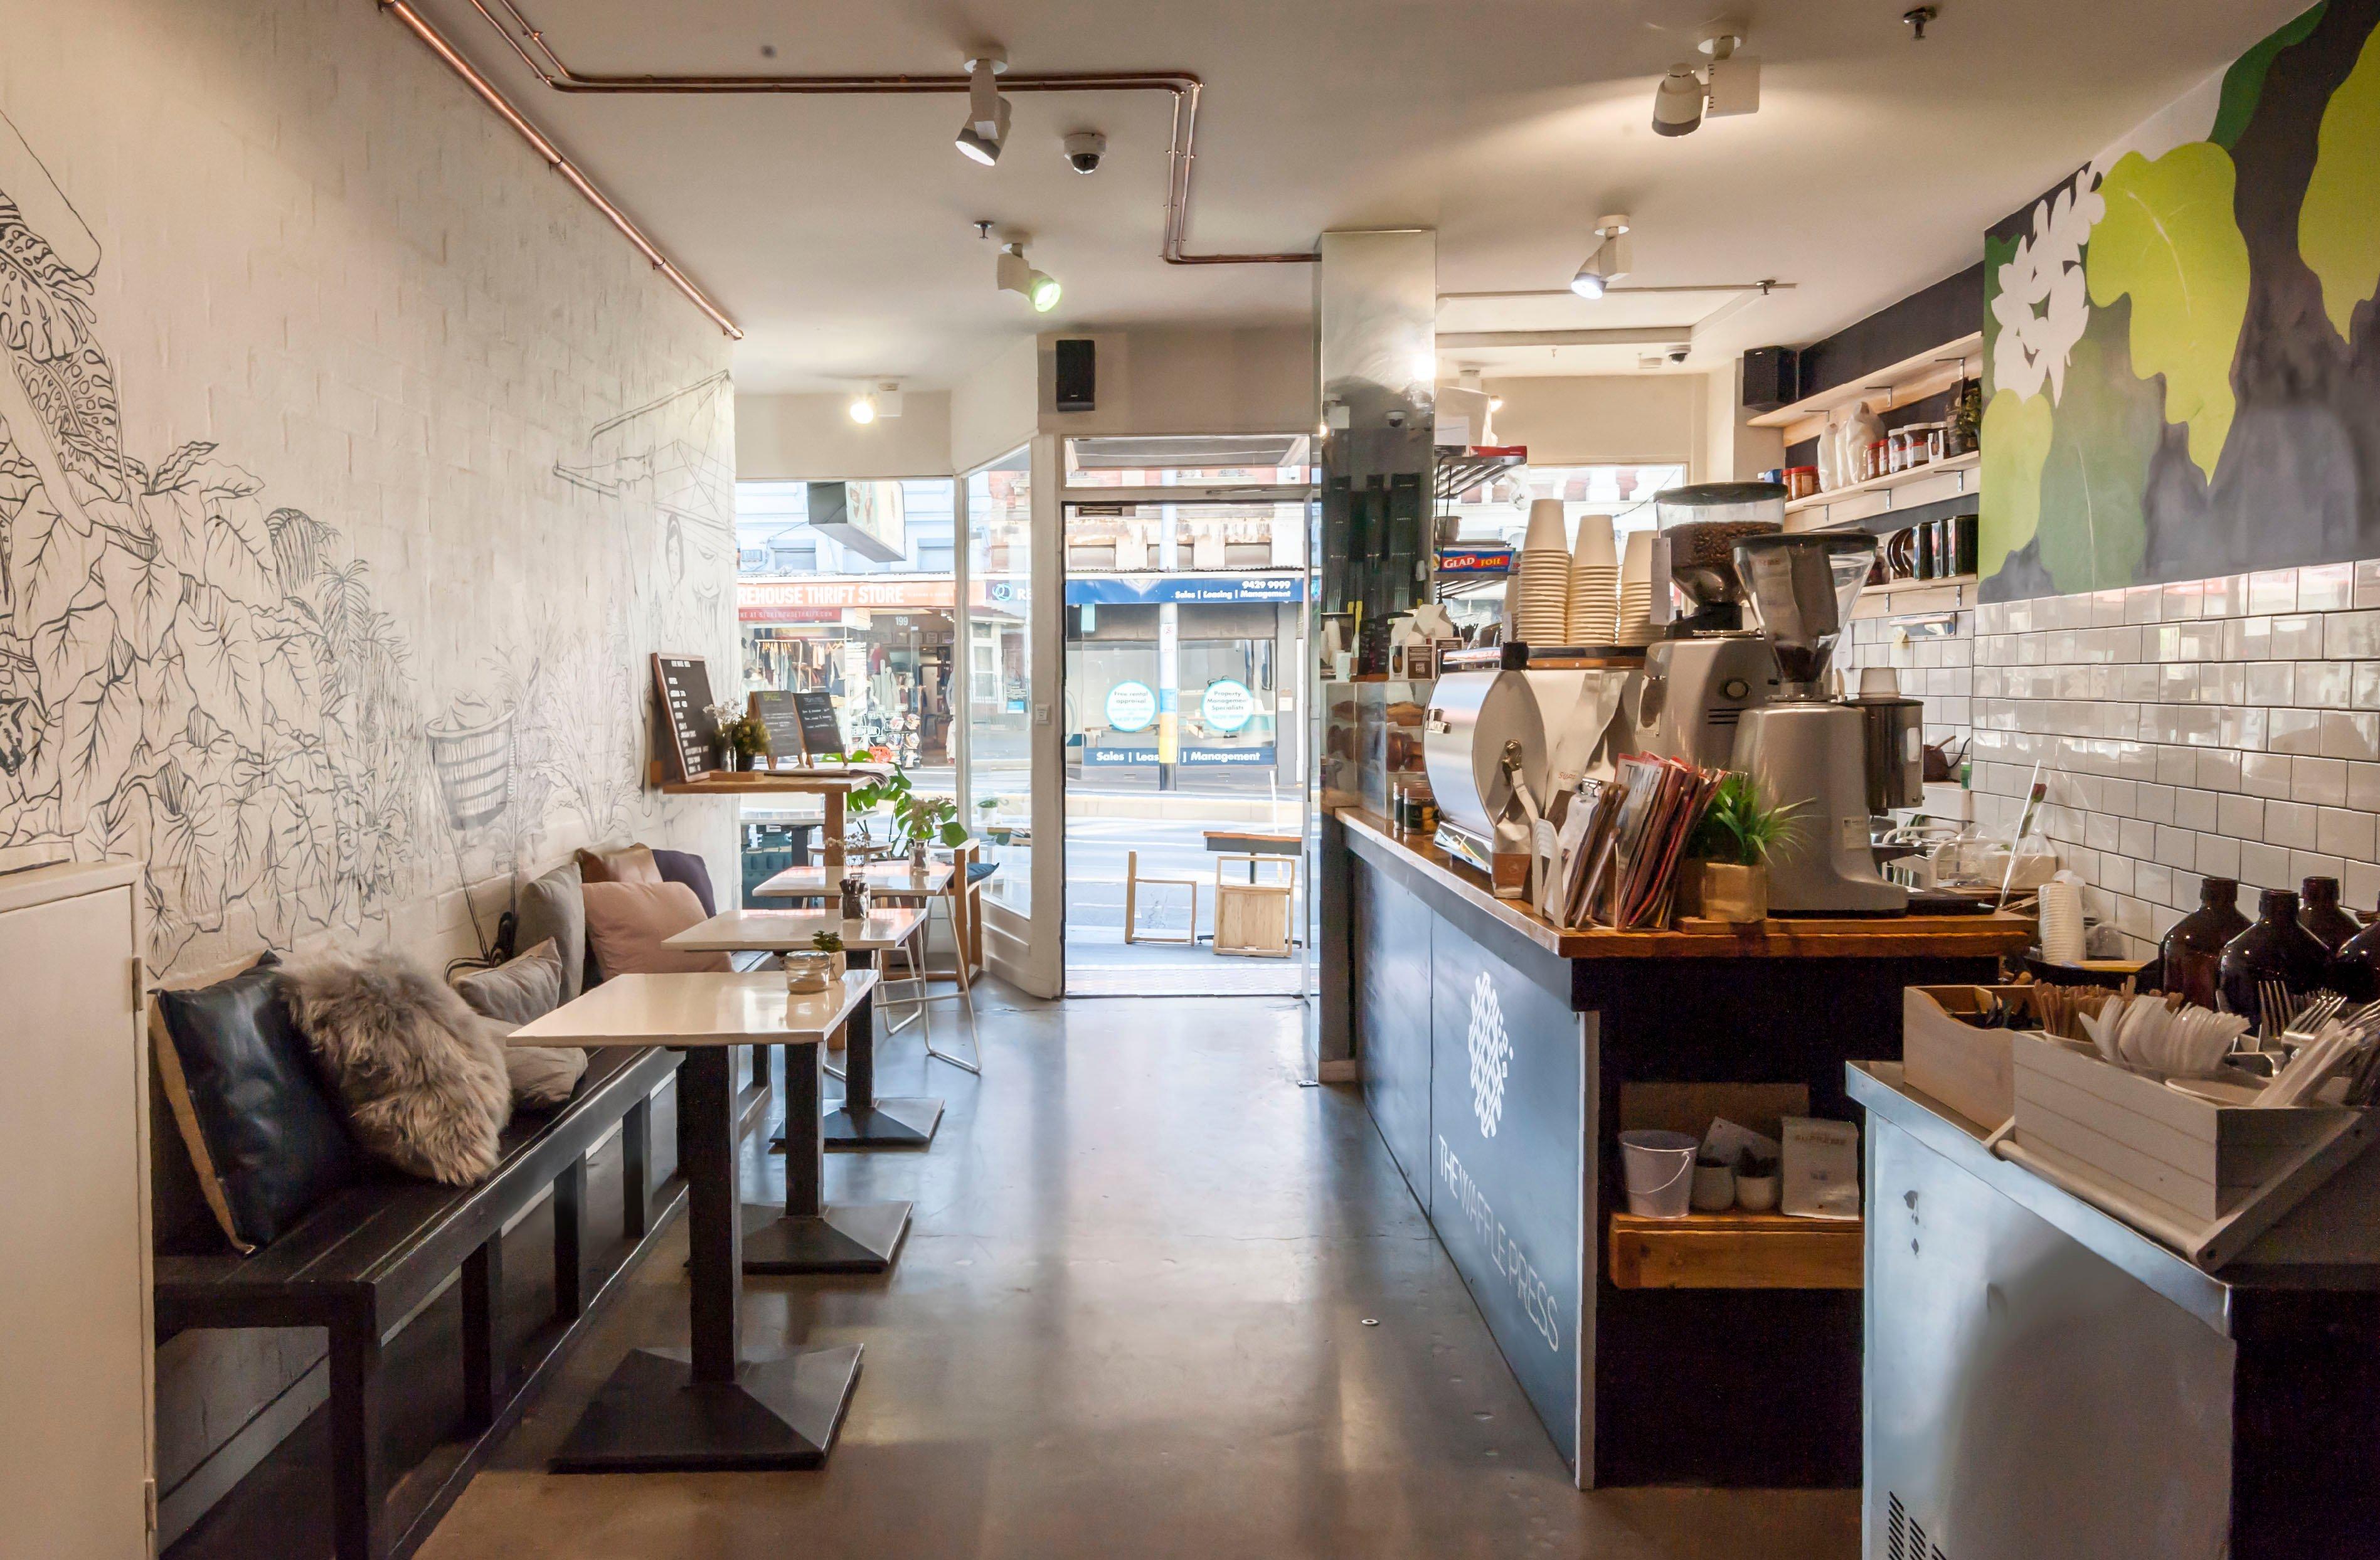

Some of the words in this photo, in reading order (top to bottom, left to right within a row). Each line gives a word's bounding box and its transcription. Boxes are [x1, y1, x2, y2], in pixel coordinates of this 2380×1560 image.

[1443, 557, 1475, 568] GLAD
[1242, 580, 1266, 589] 9429
[1267, 580, 1291, 589] 9999
[806, 586, 855, 604] THRIFT
[858, 585, 904, 603] STORE
[1175, 590, 1195, 598] Sales
[1203, 590, 1233, 600] Leasing
[1240, 590, 1291, 599] Management
[895, 616, 908, 626] 199
[1096, 751, 1125, 761] Sales
[1136, 751, 1159, 761] Leas
[1191, 751, 1261, 763] Management
[1439, 1134, 1458, 1199] THE
[1459, 1163, 1506, 1276] WAFFLE
[1509, 1238, 1559, 1352] PRESS
